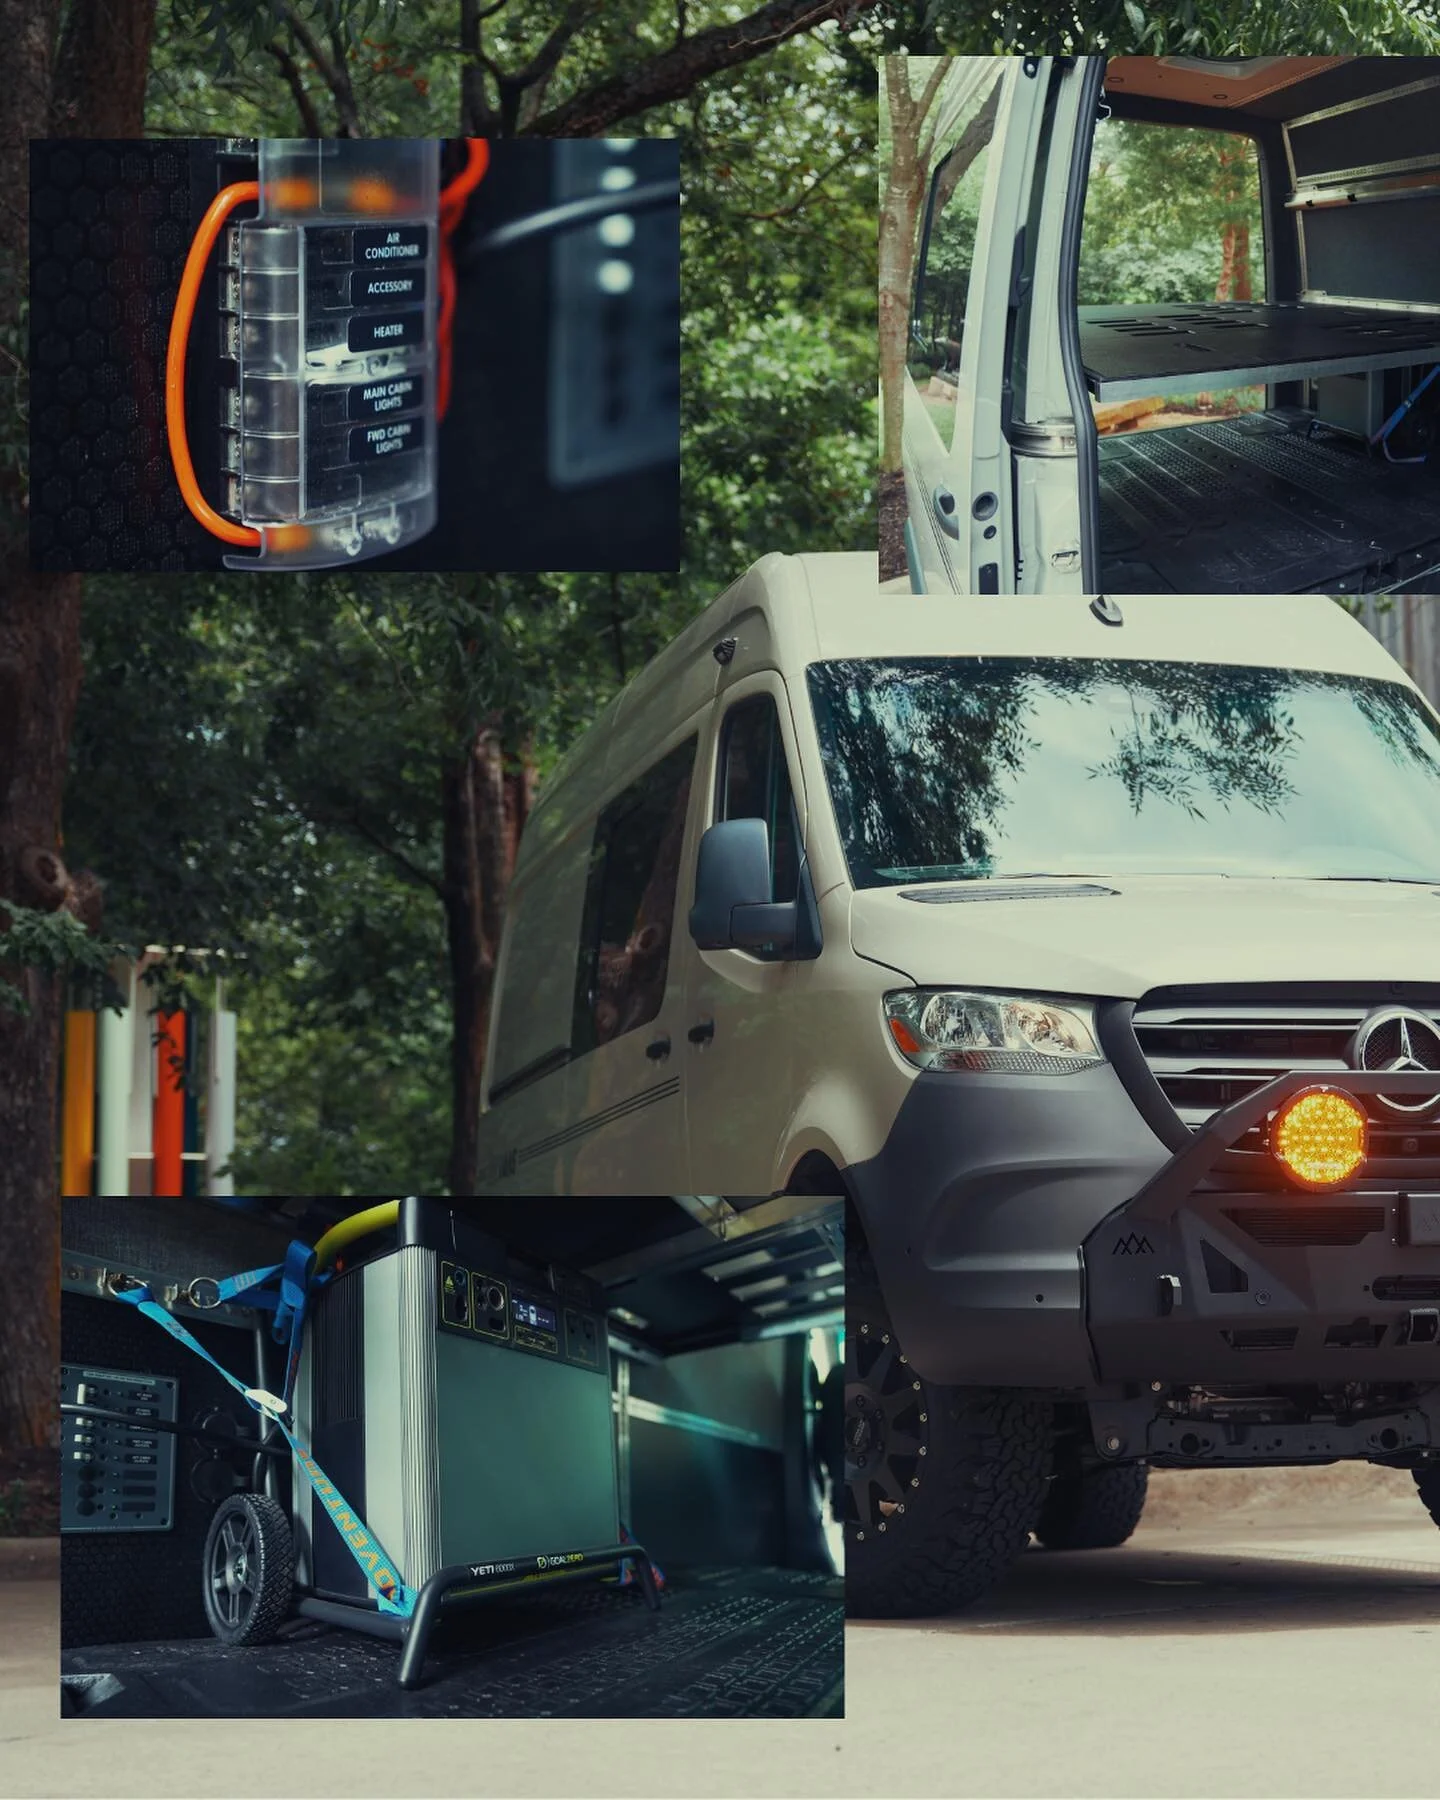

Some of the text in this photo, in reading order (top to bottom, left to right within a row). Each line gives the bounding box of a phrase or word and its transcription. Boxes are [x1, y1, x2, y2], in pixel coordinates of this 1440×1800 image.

[386, 231, 401, 244] AIR
[364, 243, 420, 260] CONDITIONER
[367, 279, 413, 294] ACCESSORY
[373, 323, 404, 339] HEATER
[363, 380, 413, 401] MAIN CABIN
[374, 396, 403, 412] LIGHTS
[366, 423, 412, 442] FWD CABIN
[375, 437, 404, 454] LIGHTS
[470, 1565, 495, 1576] YETI
